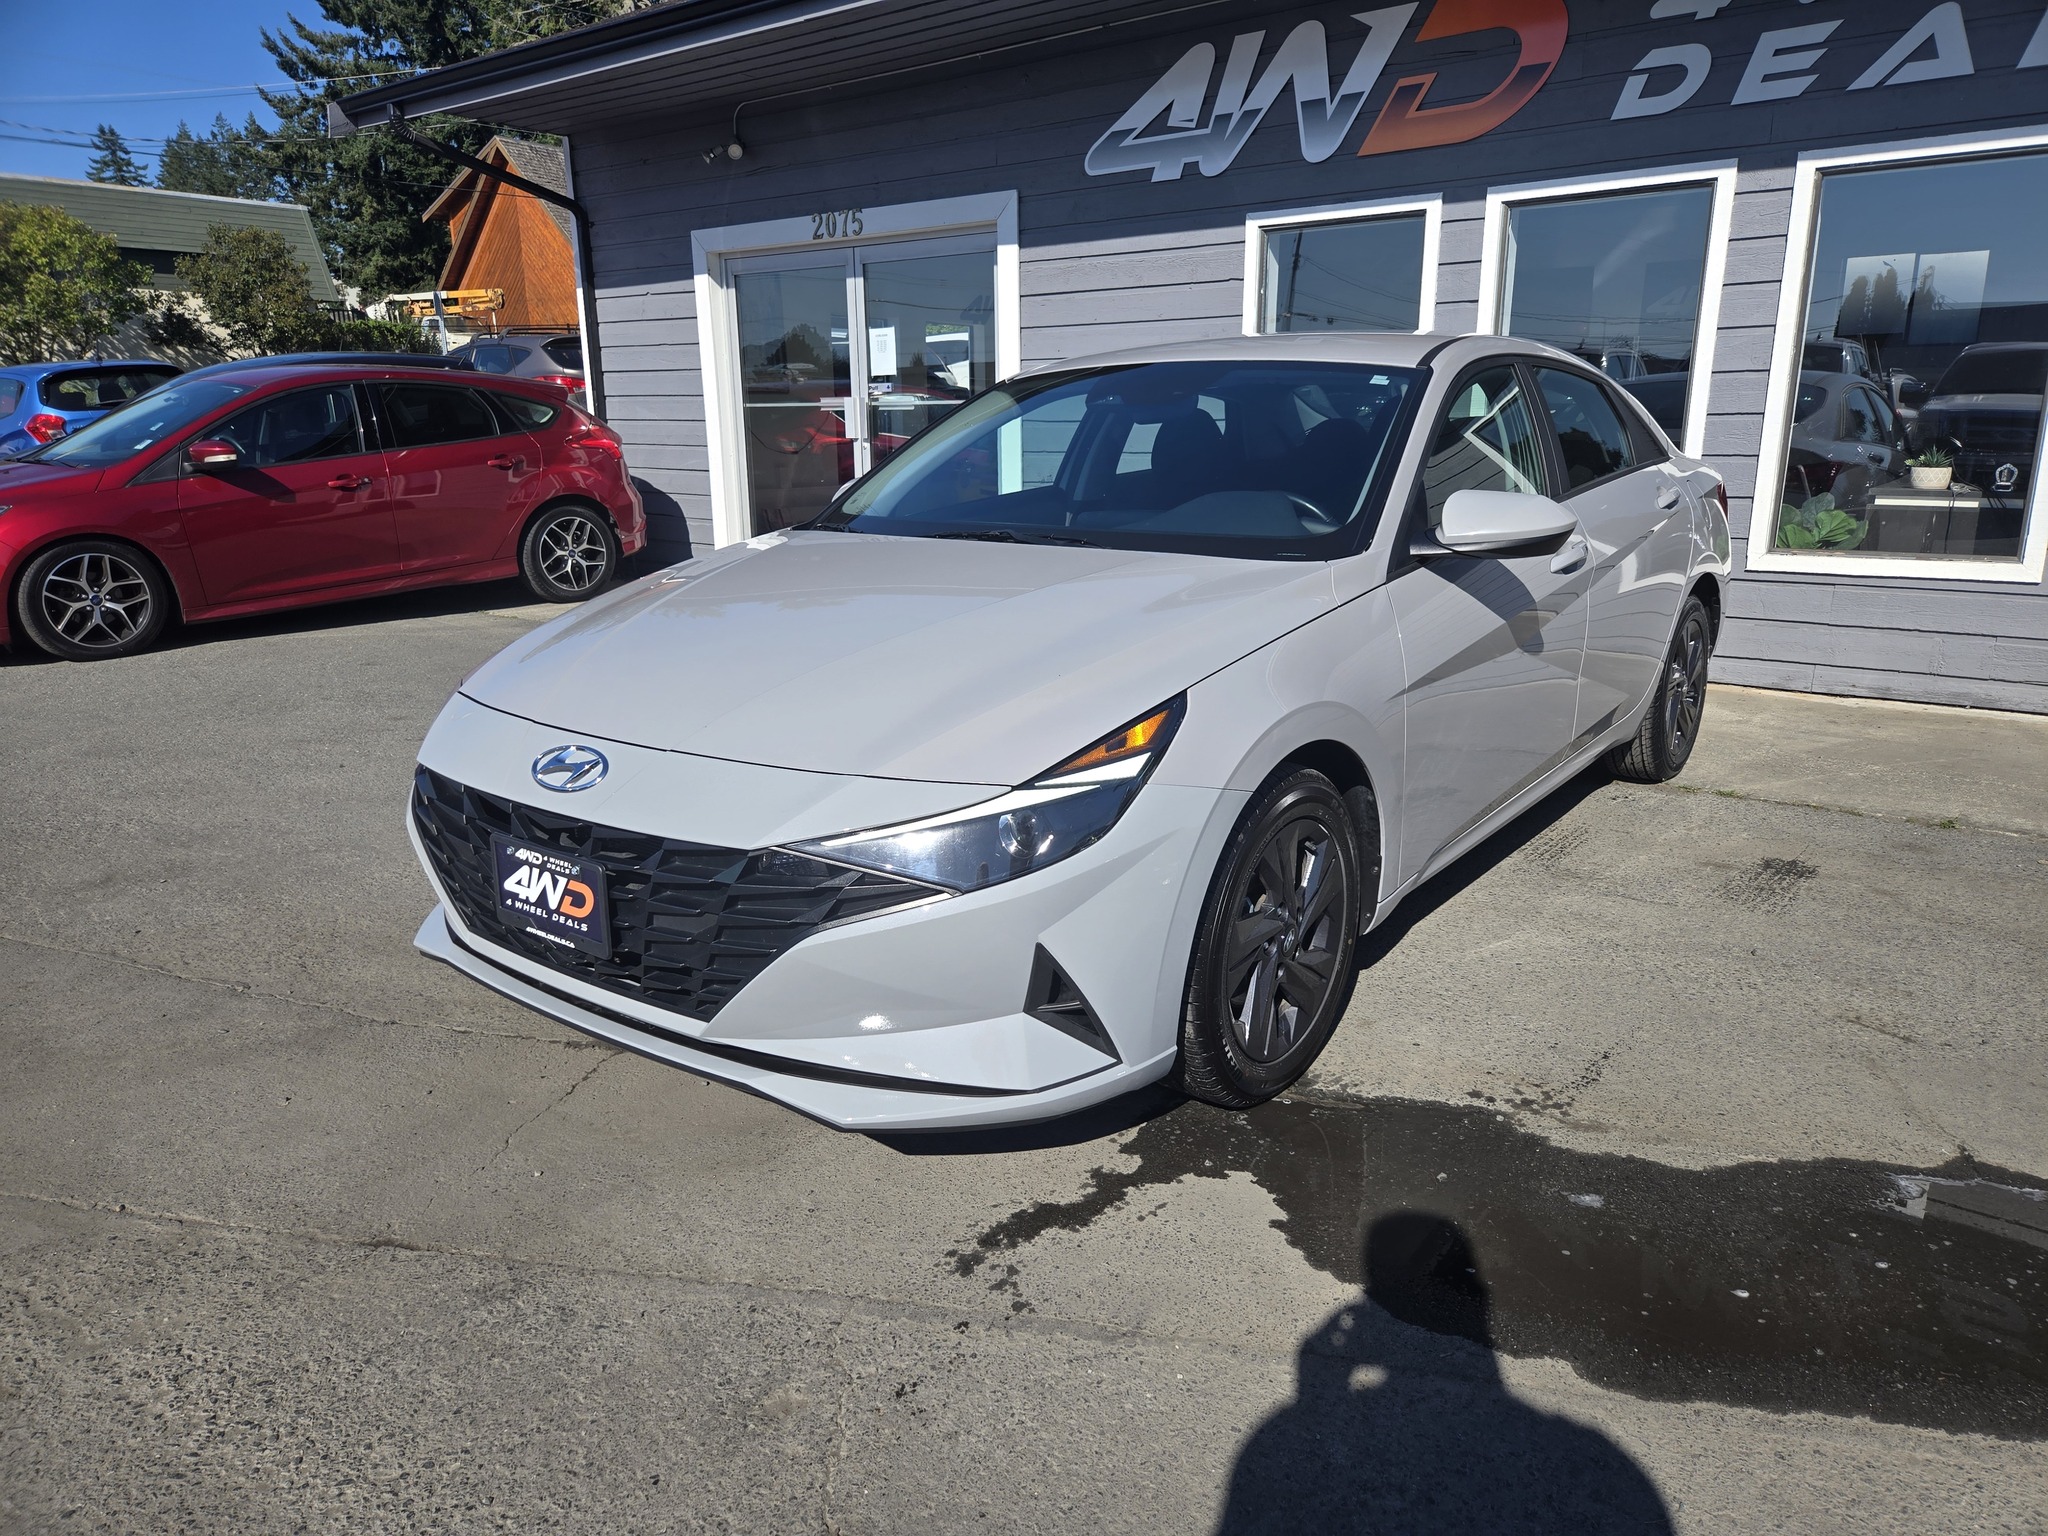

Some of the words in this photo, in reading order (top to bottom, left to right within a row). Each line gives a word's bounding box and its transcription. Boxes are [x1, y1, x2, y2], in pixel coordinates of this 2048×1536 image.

[1610, 1, 2048, 120] DEA
[1084, 0, 1570, 182] 4WD
[811, 208, 863, 240] 2075
[515, 848, 543, 865] 4WD
[546, 863, 570, 875] DEALS
[549, 857, 572, 869] WHEEL
[503, 865, 595, 919] 4WD
[506, 898, 513, 906] 4
[515, 900, 548, 918] WHEEL
[552, 913, 588, 932] DEALS
